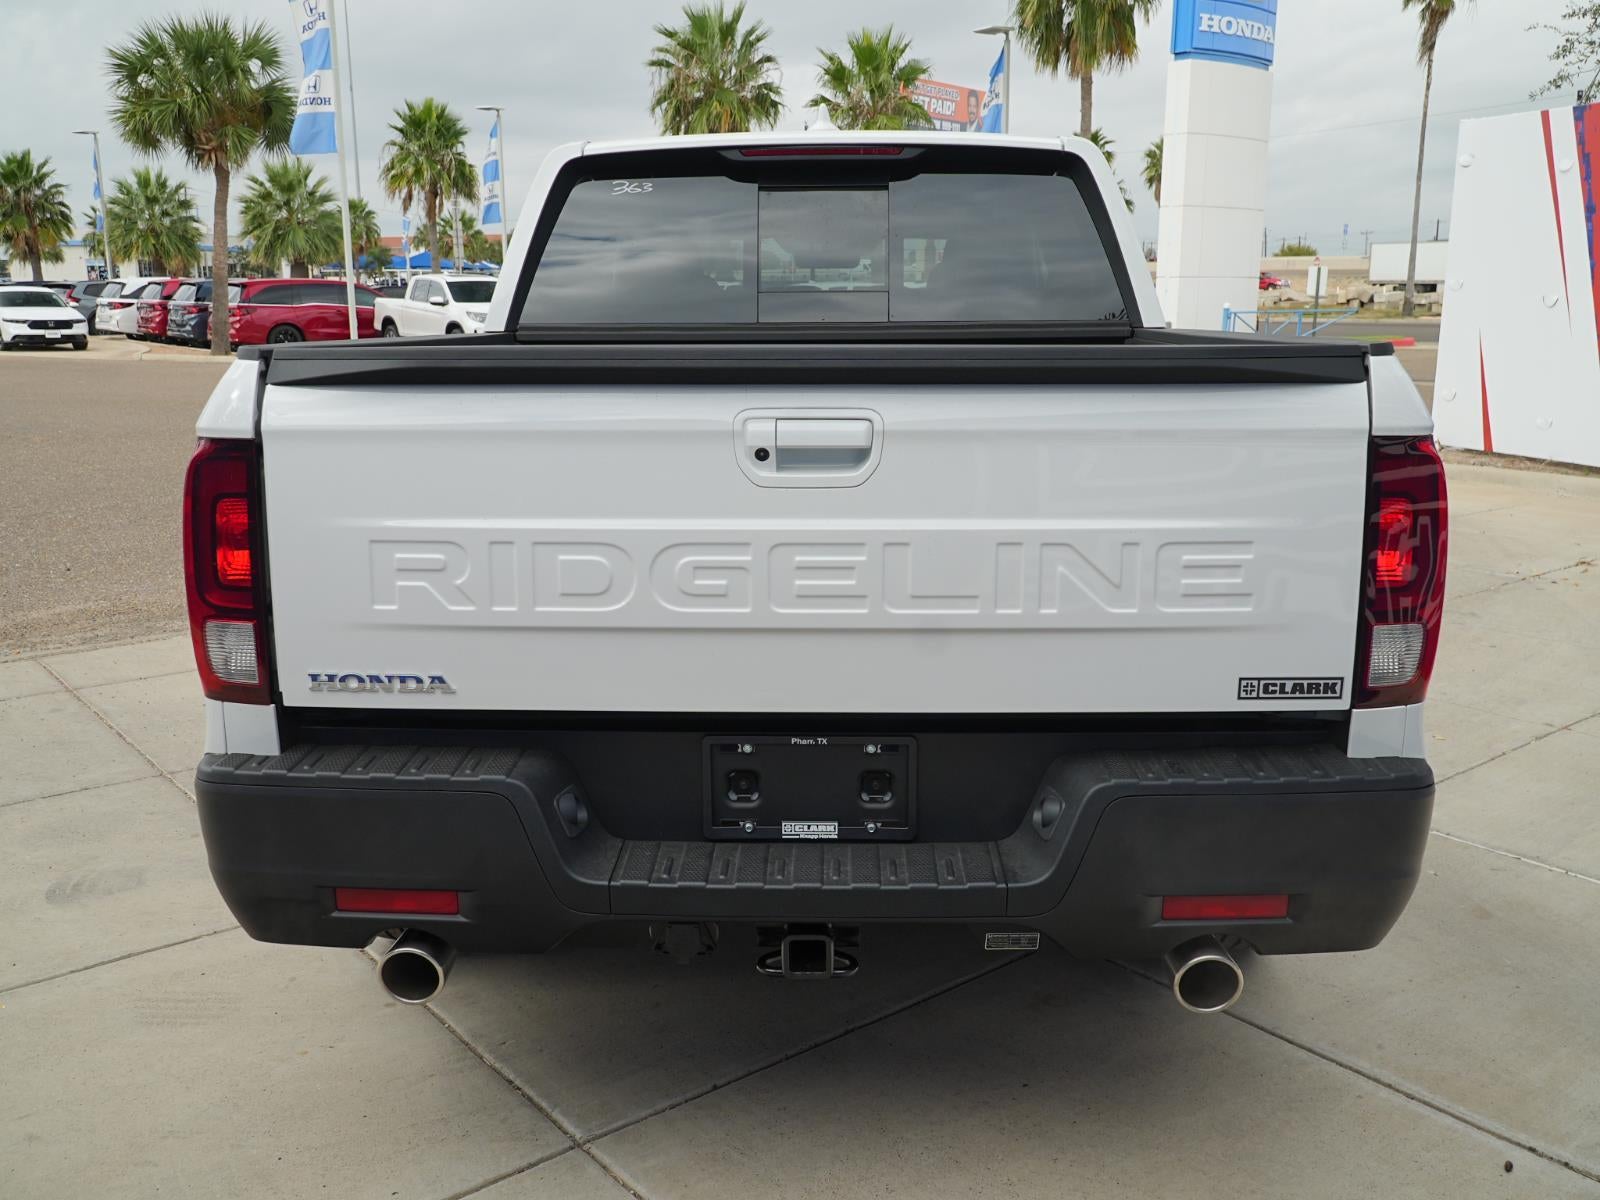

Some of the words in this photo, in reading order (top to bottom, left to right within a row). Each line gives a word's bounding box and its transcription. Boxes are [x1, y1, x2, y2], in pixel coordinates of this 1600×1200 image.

[1199, 13, 1274, 44] HONDA
[930, 98, 956, 116] PAID!
[611, 180, 654, 196] 363
[369, 540, 1254, 614] RIDGELINE
[308, 673, 457, 695] HONDA
[1262, 682, 1339, 695] CLARK
[817, 737, 828, 745] TX
[794, 824, 836, 832] CLARK
